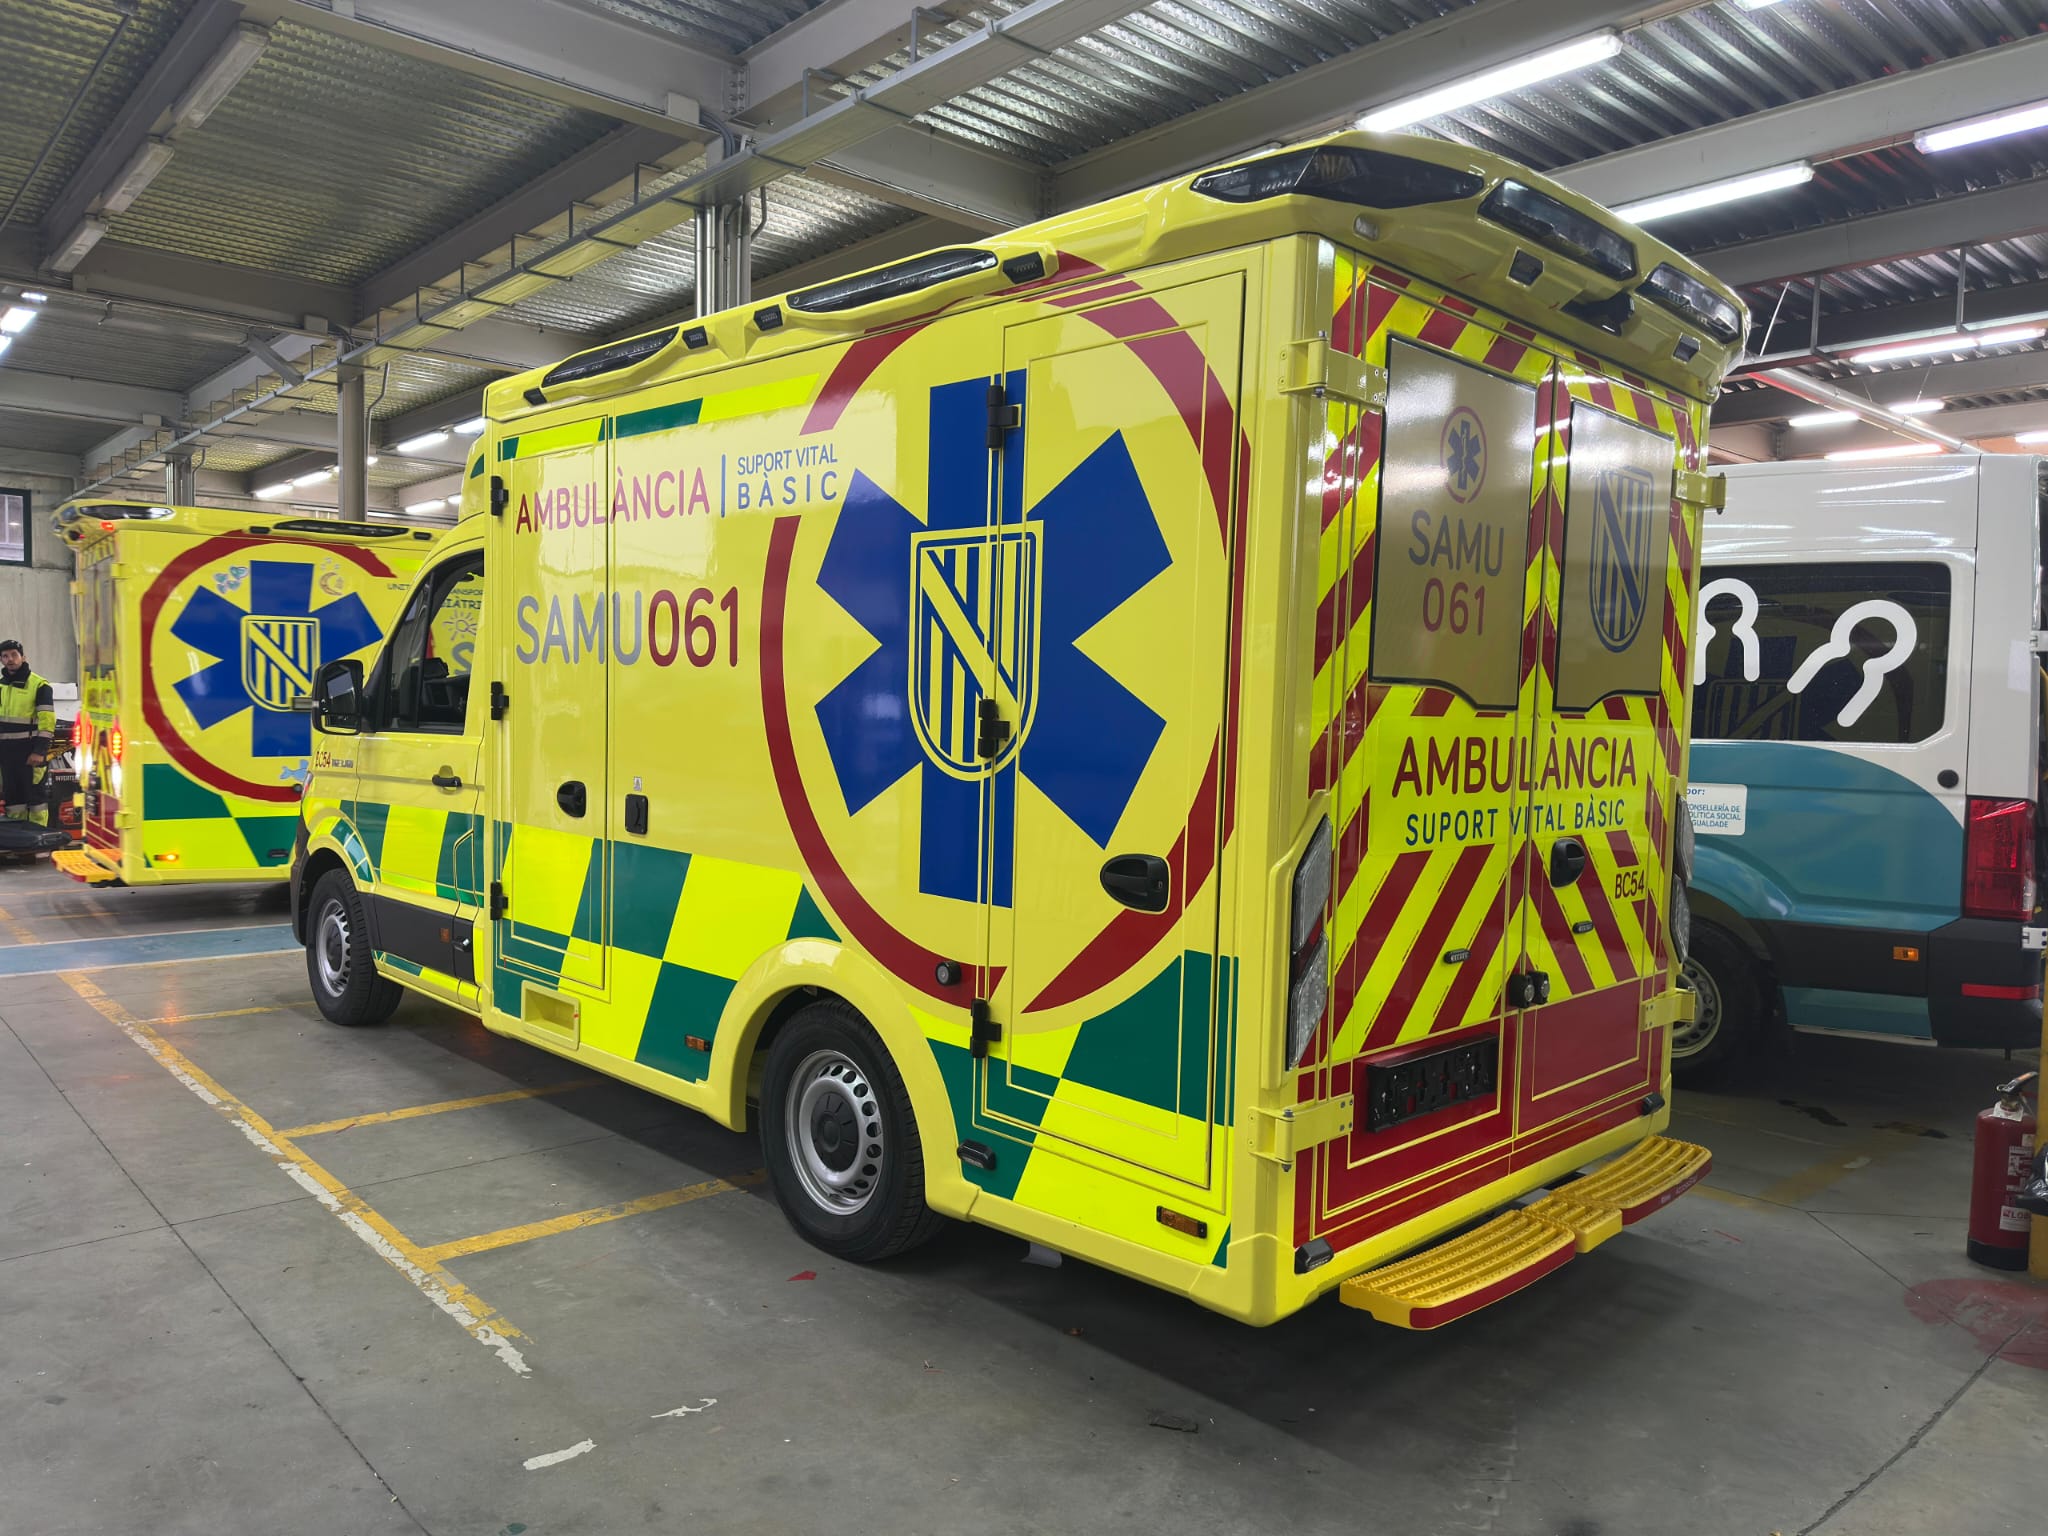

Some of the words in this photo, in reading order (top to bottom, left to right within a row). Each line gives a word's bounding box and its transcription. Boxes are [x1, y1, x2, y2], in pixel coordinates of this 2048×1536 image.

[737, 449, 793, 476] SUPORT
[795, 443, 838, 466] VITAL
[515, 466, 710, 535] AMBULÀNCIA
[737, 470, 838, 510] BÀSIC
[1408, 509, 1505, 577] SAMU
[1422, 577, 1486, 637] 061
[1391, 722, 1637, 799] AMBULÀNCIA
[1405, 808, 1498, 846] SUPORT
[1509, 804, 1566, 835] VITAL
[1574, 794, 1625, 830] BÀSIC
[1688, 803, 1729, 812] ONSELLERÍA
[1731, 805, 1741, 813] DE
[1692, 819, 1728, 828] GUALDADE
[1716, 812, 1741, 821] SOCIAL
[1614, 870, 1646, 899] BC54
